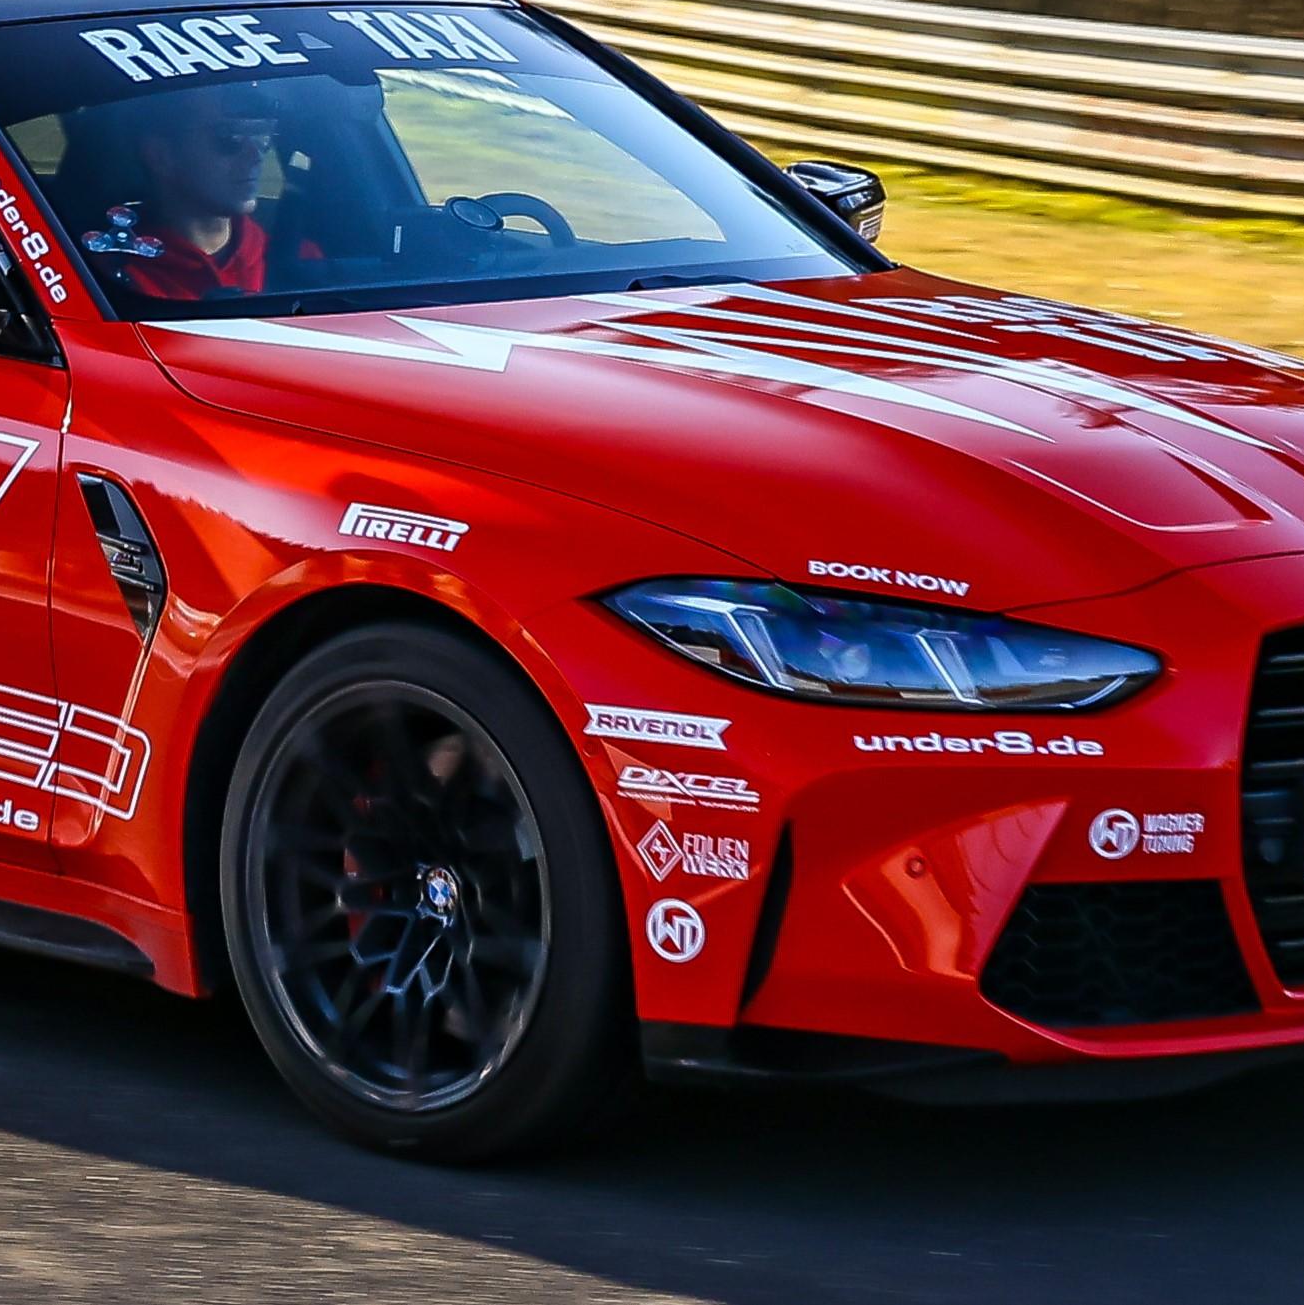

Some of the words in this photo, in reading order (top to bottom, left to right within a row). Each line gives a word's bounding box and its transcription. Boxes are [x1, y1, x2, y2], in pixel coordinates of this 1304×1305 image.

[79, 14, 309, 82] RACE
[327, 10, 520, 63] TAXI
[338, 502, 470, 551] PIRELLI
[808, 559, 892, 585] BOOK
[895, 569, 970, 597] NOW
[596, 712, 715, 741] RAVENOL
[853, 731, 1105, 756] under8.de
[618, 765, 751, 796] DIXCEL
